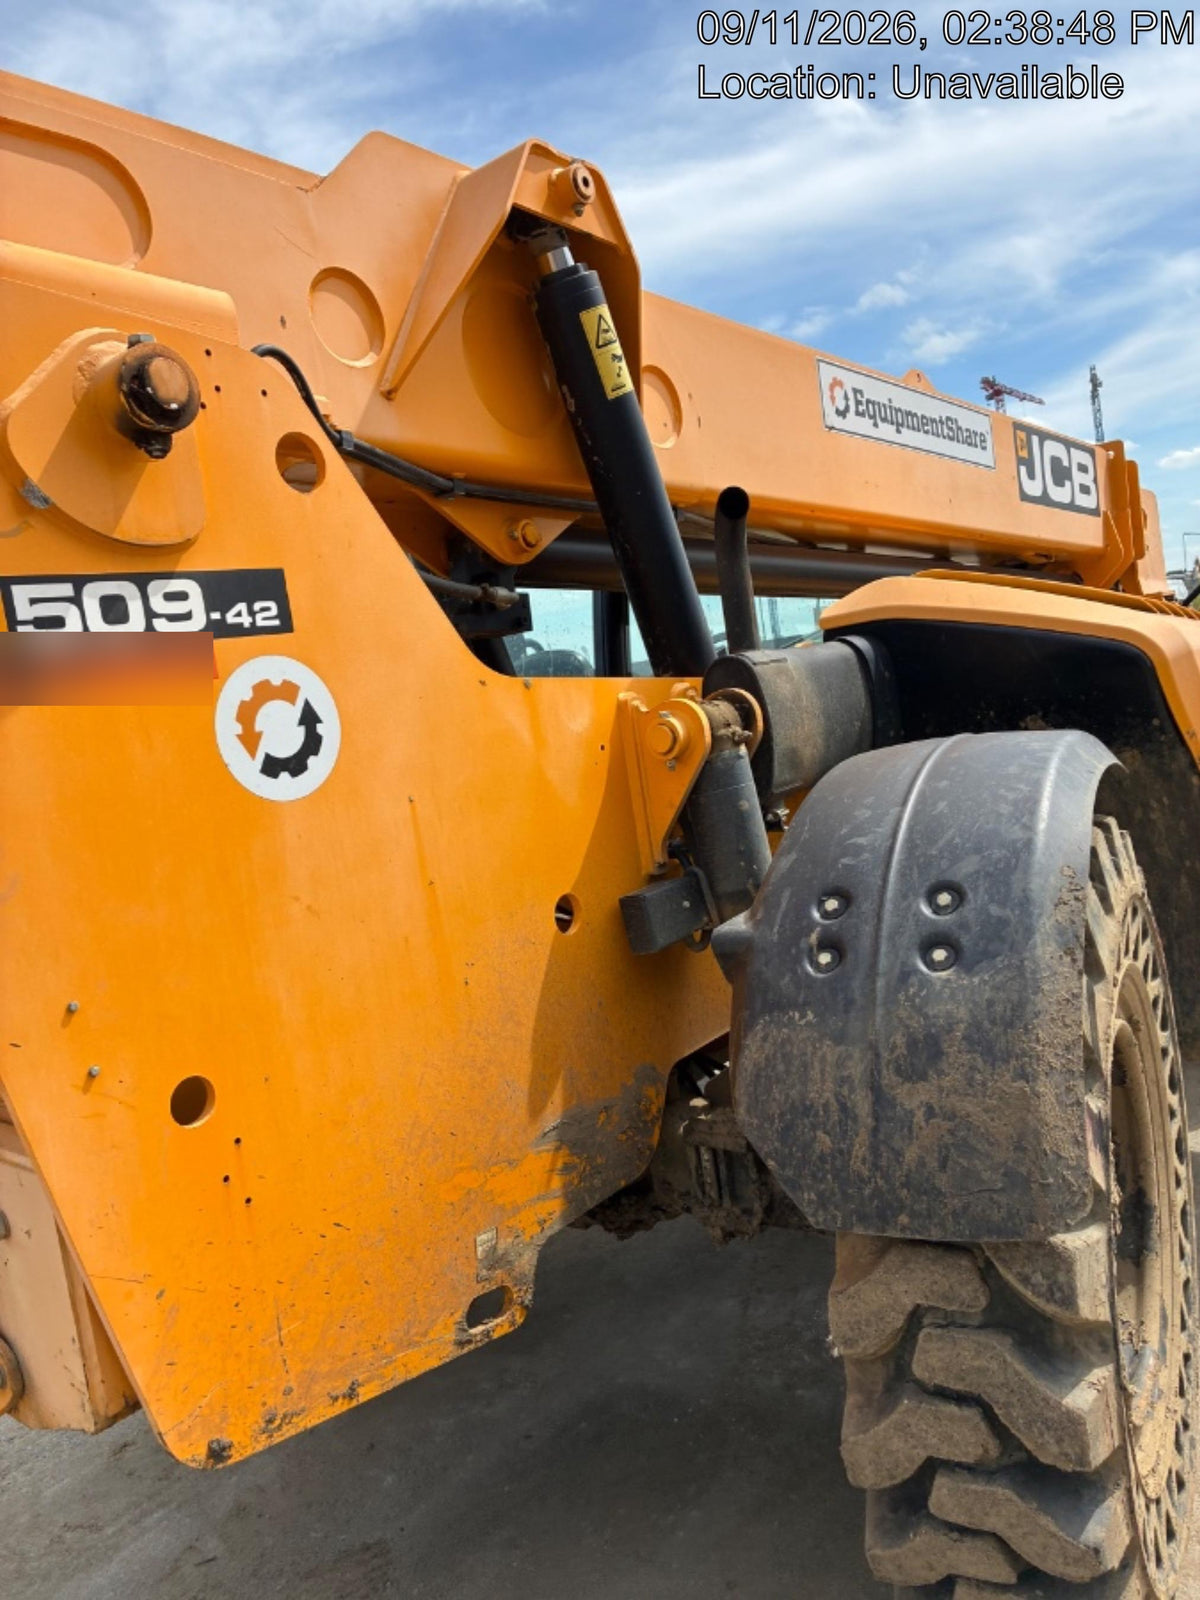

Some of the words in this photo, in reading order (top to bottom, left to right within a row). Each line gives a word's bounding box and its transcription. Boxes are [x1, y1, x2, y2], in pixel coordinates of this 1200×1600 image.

[851, 386, 988, 451] EquipmentShare
[1019, 434, 1098, 510] JCB
[10, 579, 281, 632] 509-42
